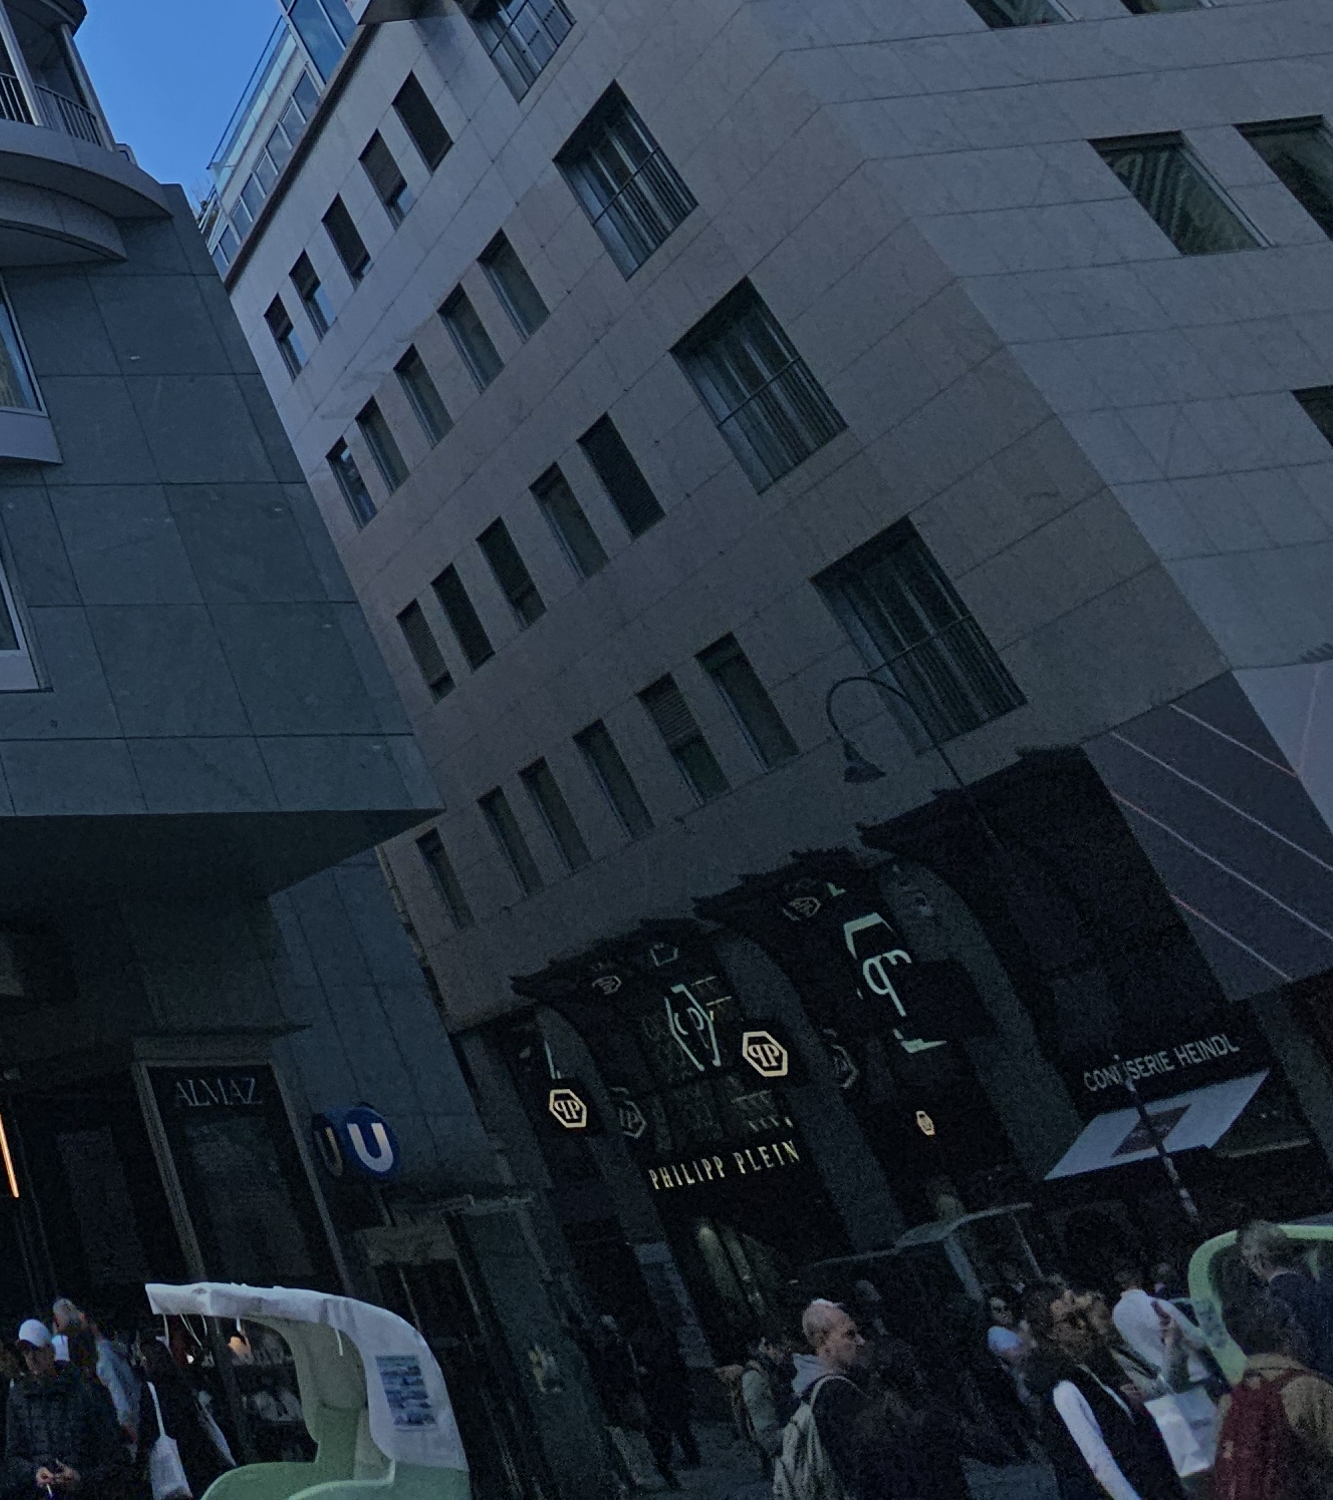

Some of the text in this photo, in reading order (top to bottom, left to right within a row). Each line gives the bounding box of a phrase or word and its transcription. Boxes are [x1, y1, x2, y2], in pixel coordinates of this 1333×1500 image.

[1173, 1033, 1240, 1066] HEINDL
[175, 1076, 263, 1107] ALMAZ
[347, 1122, 394, 1172] U
[648, 1140, 800, 1190] PHILIPP PLEIN
